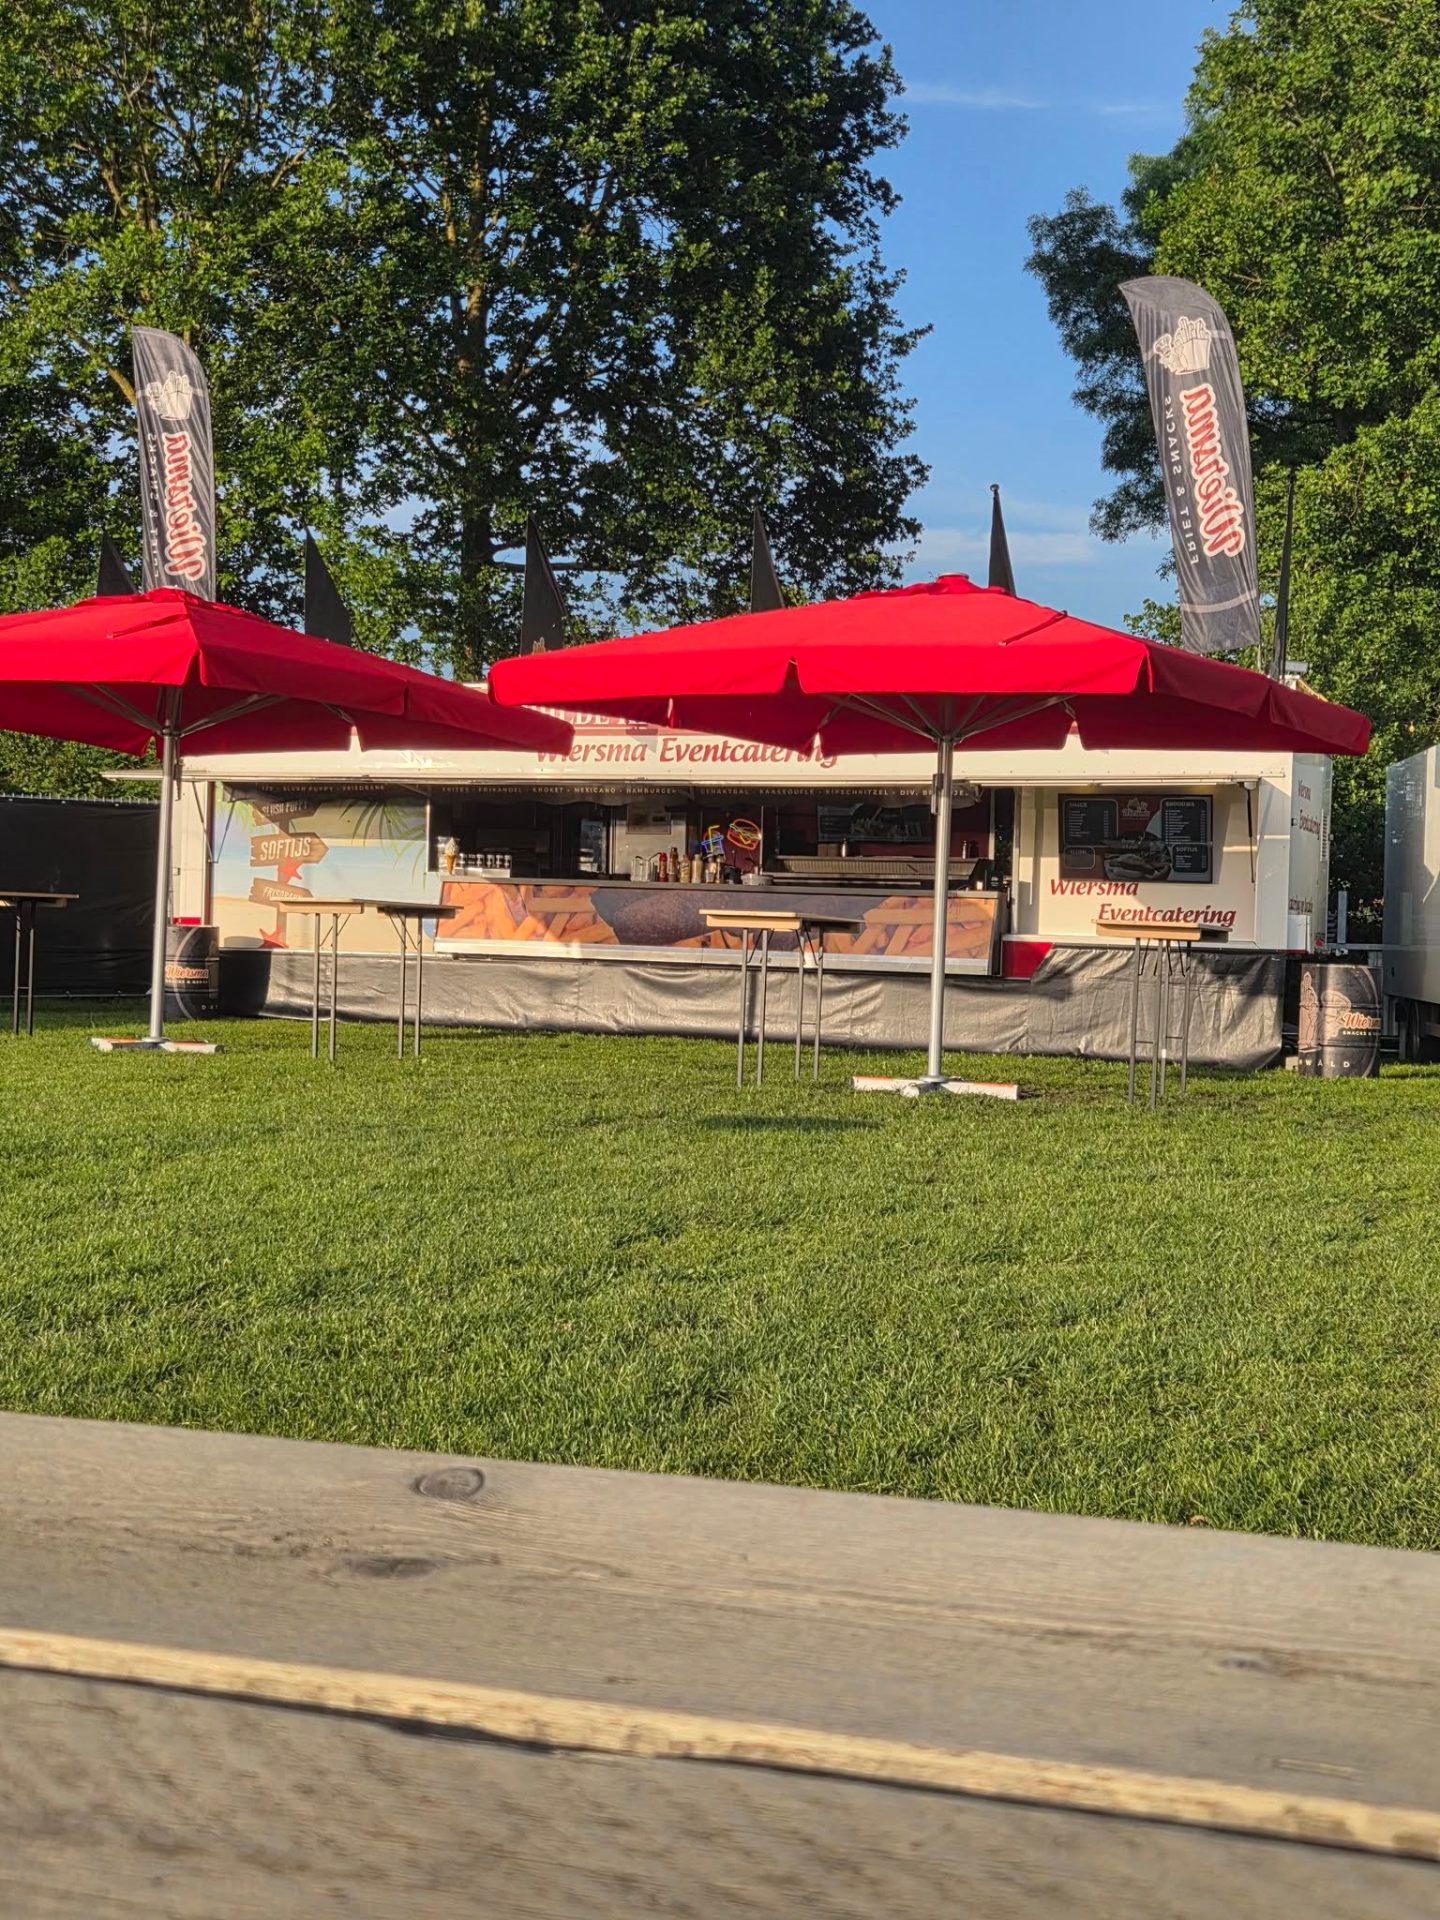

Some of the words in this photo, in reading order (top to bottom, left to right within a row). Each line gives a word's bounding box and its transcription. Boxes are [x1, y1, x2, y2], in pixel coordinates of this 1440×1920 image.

[260, 838, 311, 861] SOFTIJS
[1050, 879, 1139, 897] Wiersma
[1098, 903, 1237, 927] Eventcatering
